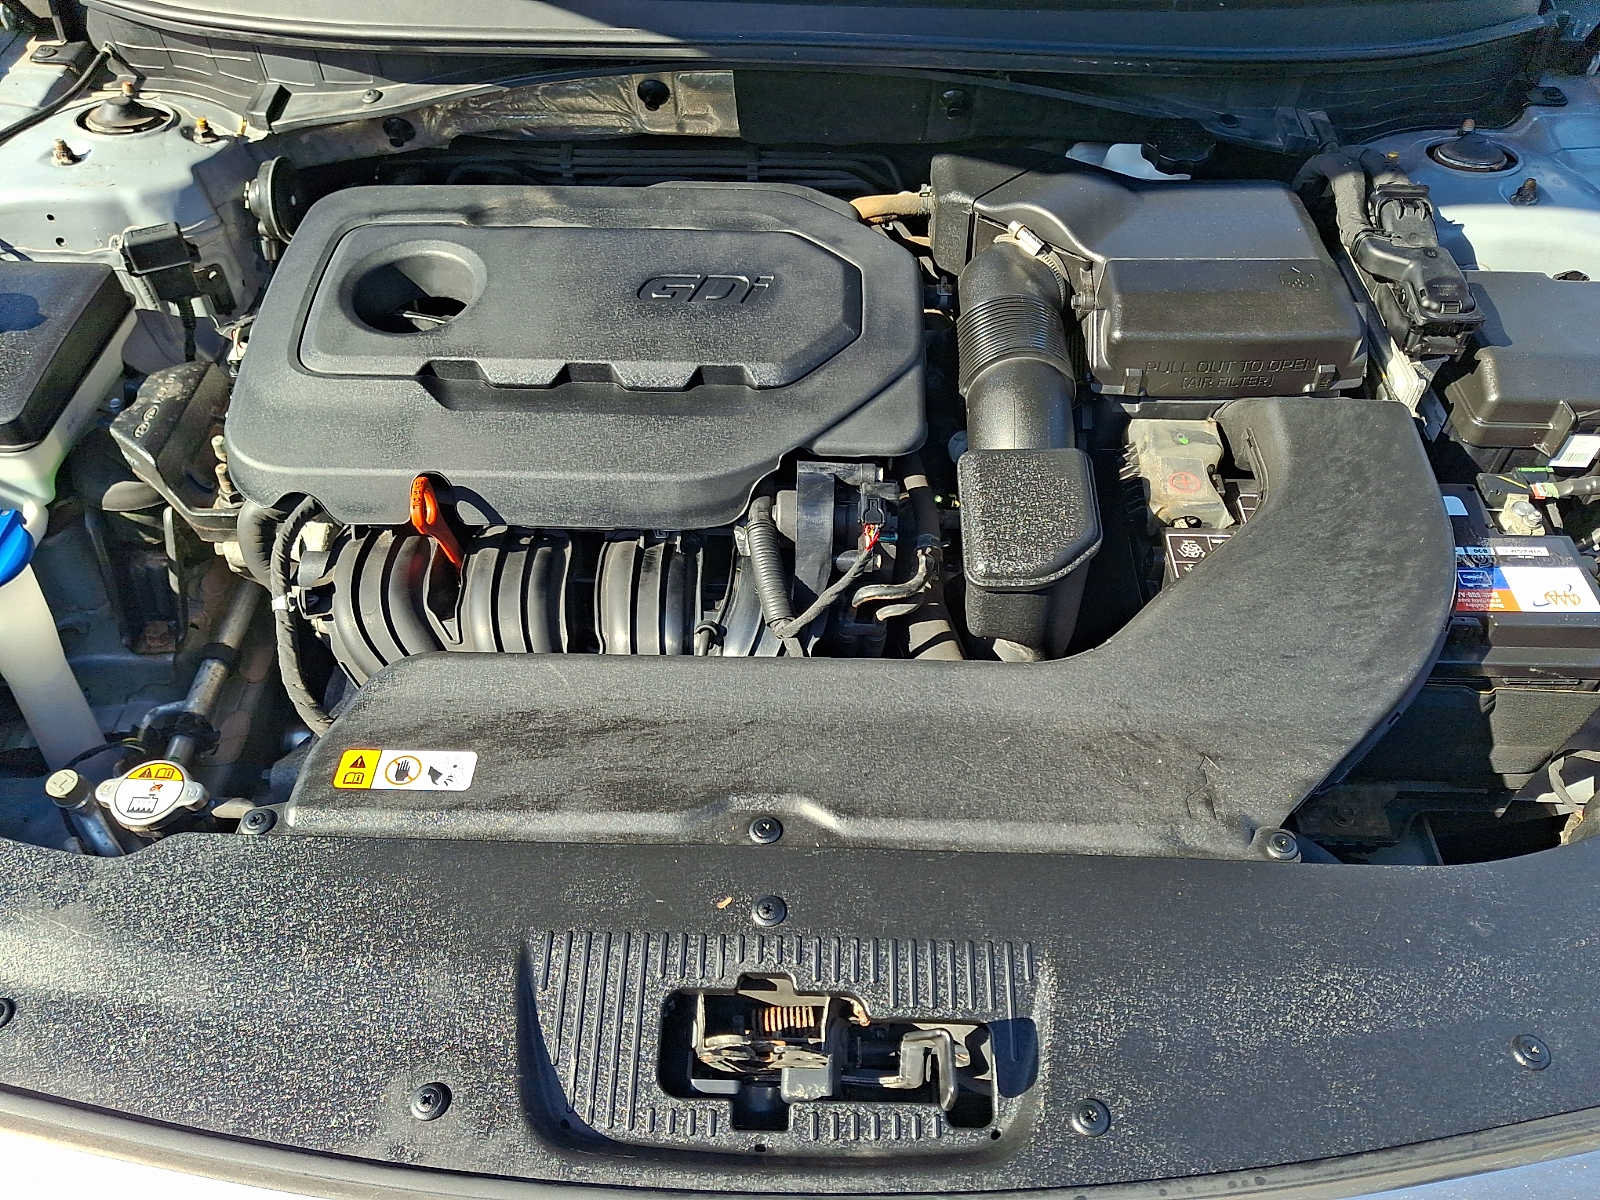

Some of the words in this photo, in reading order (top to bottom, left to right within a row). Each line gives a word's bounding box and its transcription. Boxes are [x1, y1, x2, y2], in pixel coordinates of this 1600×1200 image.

[1145, 360, 1192, 374] PULL
[1196, 360, 1237, 374] OUT
[1239, 360, 1264, 373] TO
[1269, 359, 1319, 373] OPEN
